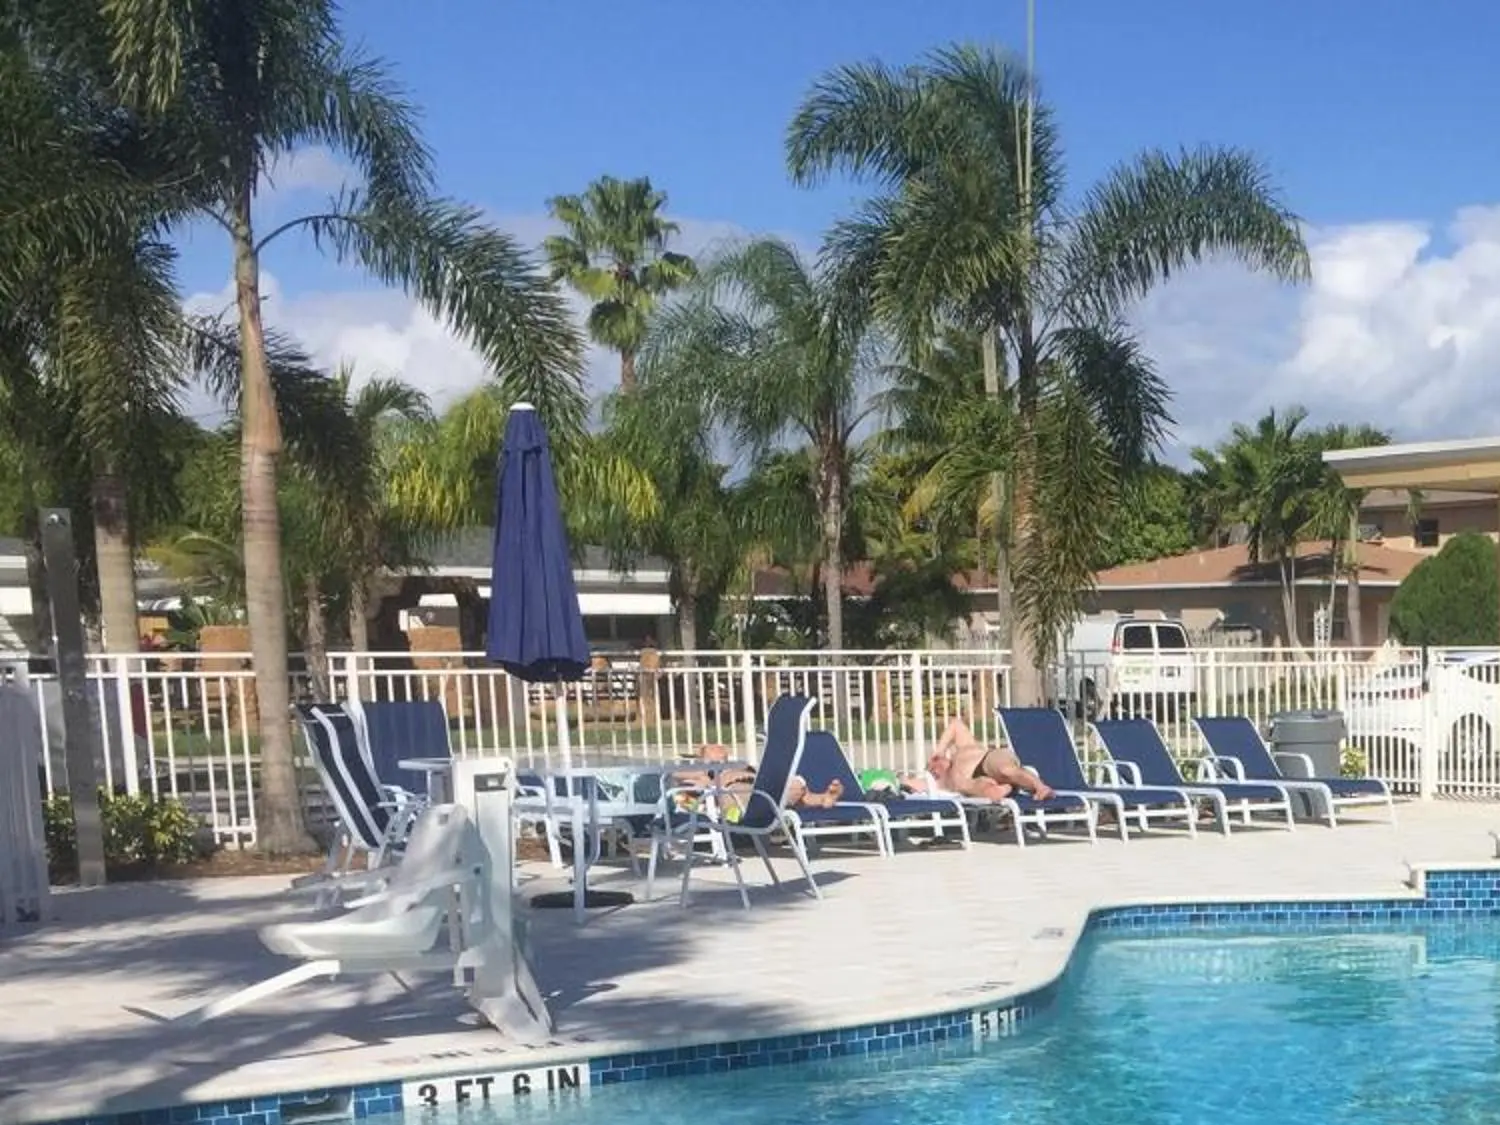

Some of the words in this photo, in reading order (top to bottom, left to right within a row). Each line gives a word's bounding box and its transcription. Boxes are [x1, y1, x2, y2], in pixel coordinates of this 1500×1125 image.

[418, 1083, 439, 1107] 3
[455, 1076, 495, 1103] FT
[512, 1072, 531, 1096] 6
[546, 1066, 581, 1091] IN
